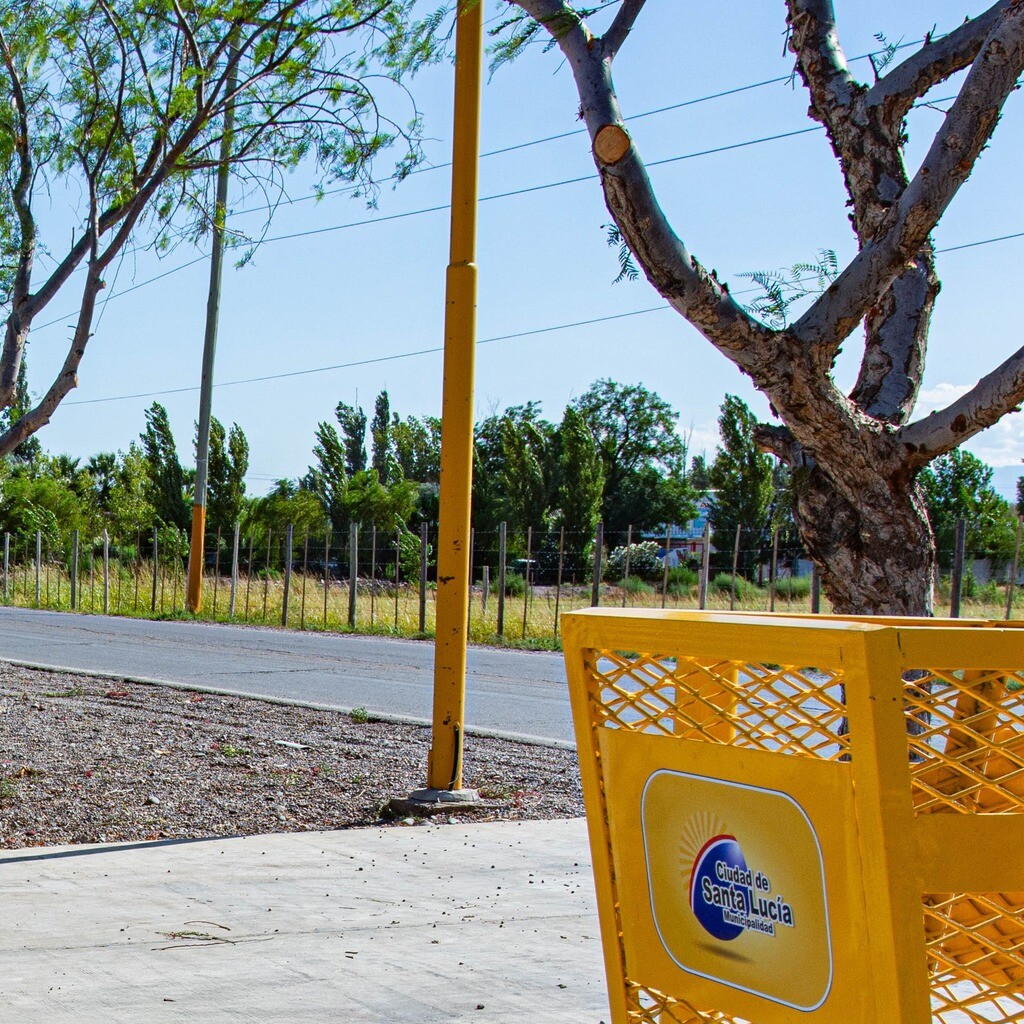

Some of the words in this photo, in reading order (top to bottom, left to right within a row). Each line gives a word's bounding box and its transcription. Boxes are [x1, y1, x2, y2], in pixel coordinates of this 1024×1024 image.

[716, 861, 753, 887] Ciudad
[755, 872, 769, 891] de
[702, 876, 746, 912] Santa
[748, 890, 793, 925] Lucía
[724, 910, 774, 935] Municipalidad
